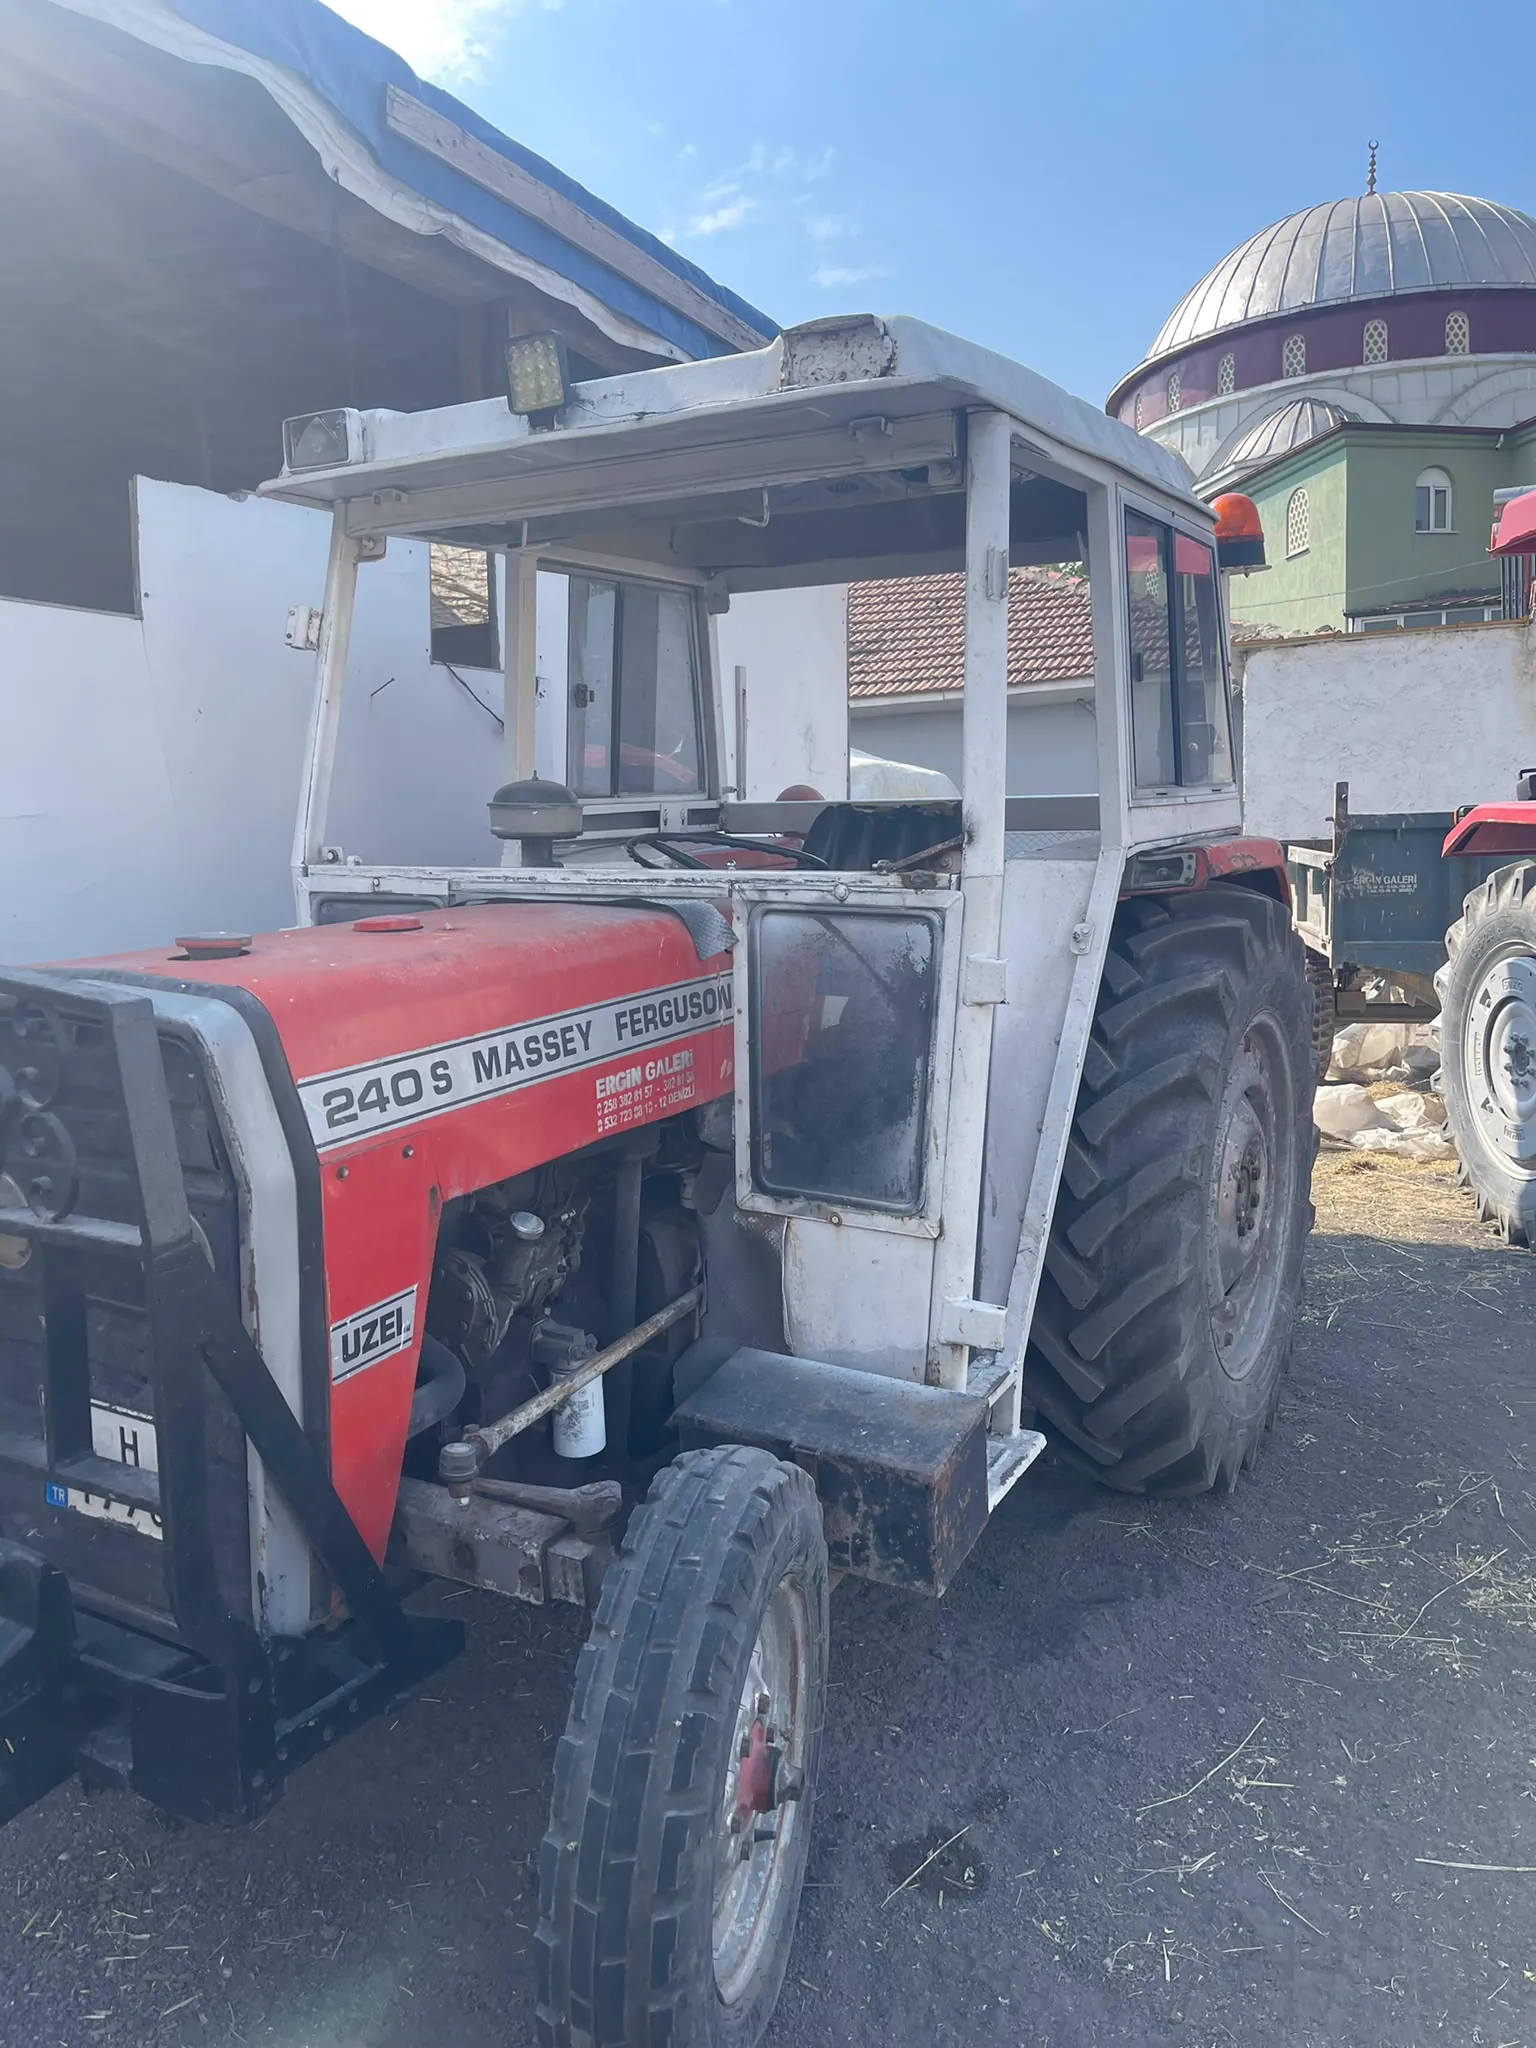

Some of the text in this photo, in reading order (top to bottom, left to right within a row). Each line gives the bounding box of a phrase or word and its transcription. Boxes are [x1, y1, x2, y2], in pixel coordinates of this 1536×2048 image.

[472, 1020, 592, 1084] MASSEY
[615, 984, 732, 1041] FERGUSON
[644, 1085, 653, 1099] 57
[604, 1115, 618, 1130] 532
[620, 1109, 632, 1123] 723
[659, 1095, 667, 1109] 12
[52, 1486, 66, 1501] TR
